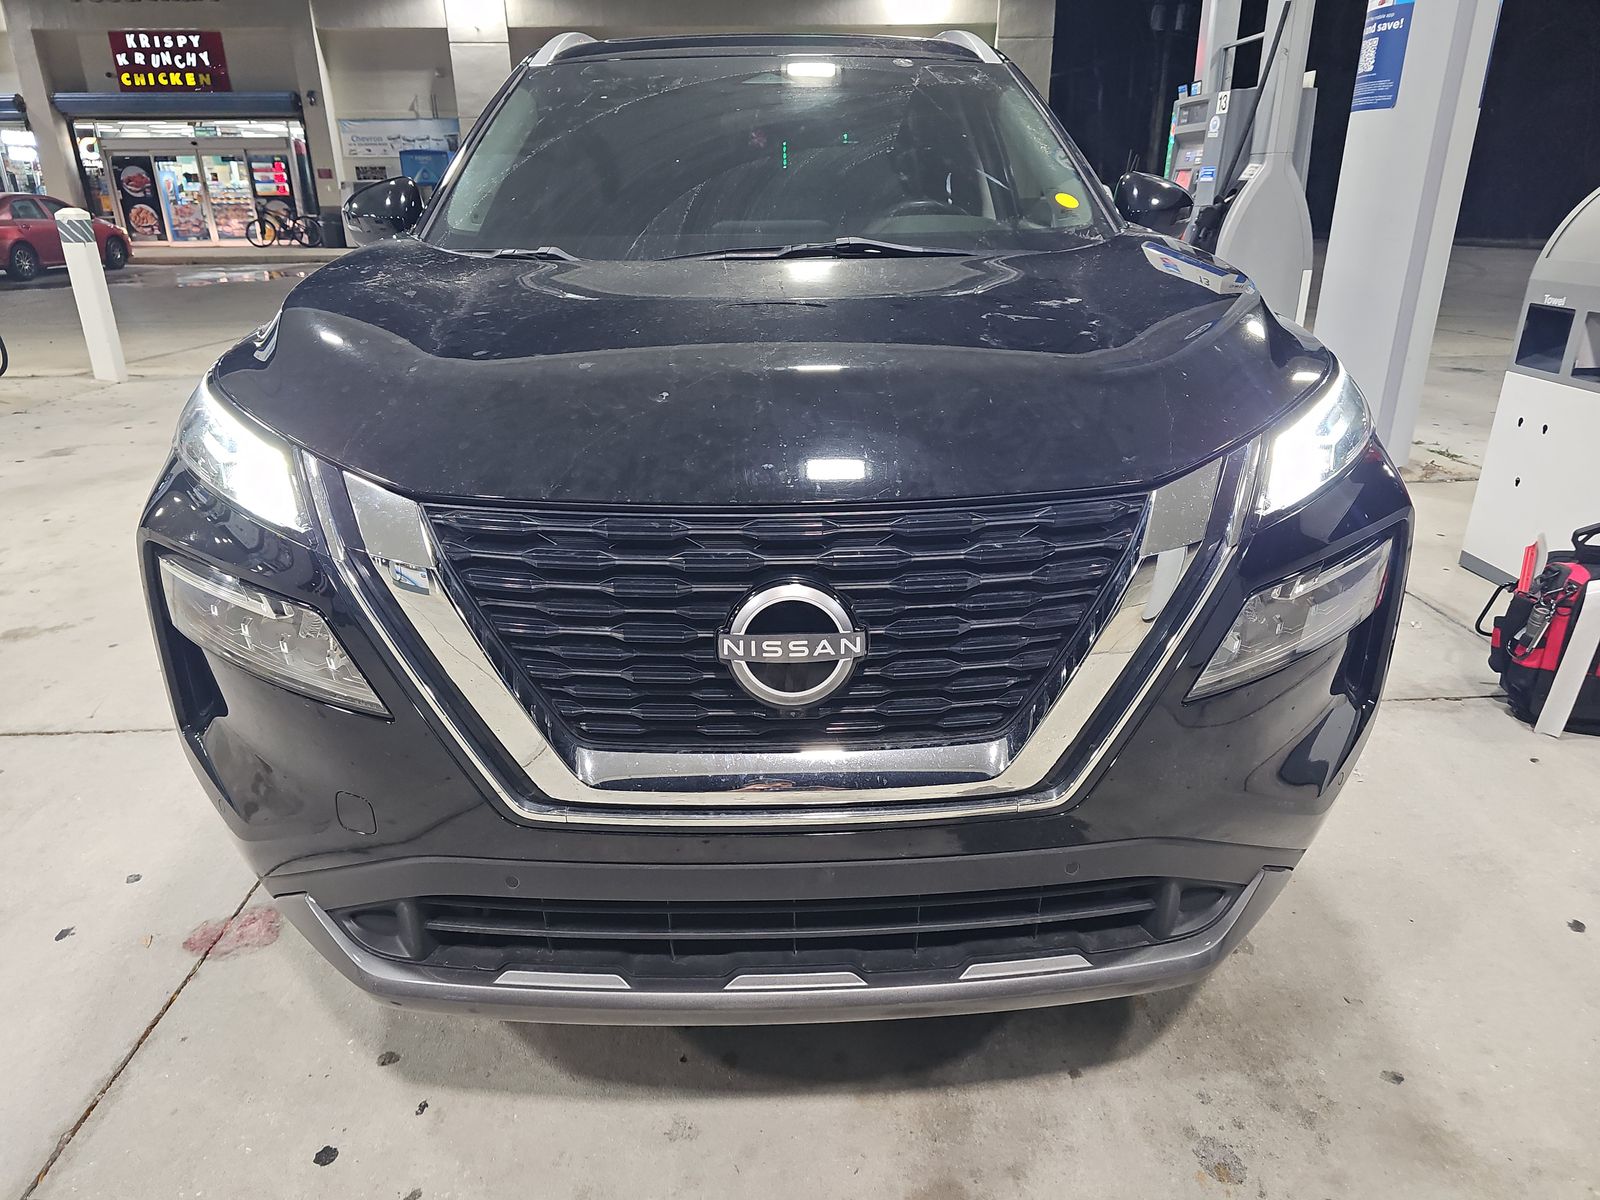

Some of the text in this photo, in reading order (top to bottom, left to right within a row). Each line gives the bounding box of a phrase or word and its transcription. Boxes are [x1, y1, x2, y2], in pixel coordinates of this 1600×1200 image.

[1376, 17, 1405, 32] save!
[125, 33, 200, 49] KRISPY
[116, 51, 211, 69] KRUNCHY
[121, 72, 212, 86] CHICKEN
[1218, 94, 1228, 111] 13
[351, 135, 384, 143] Chevron
[1544, 294, 1567, 306] Towel
[723, 636, 862, 658] NISSAN
